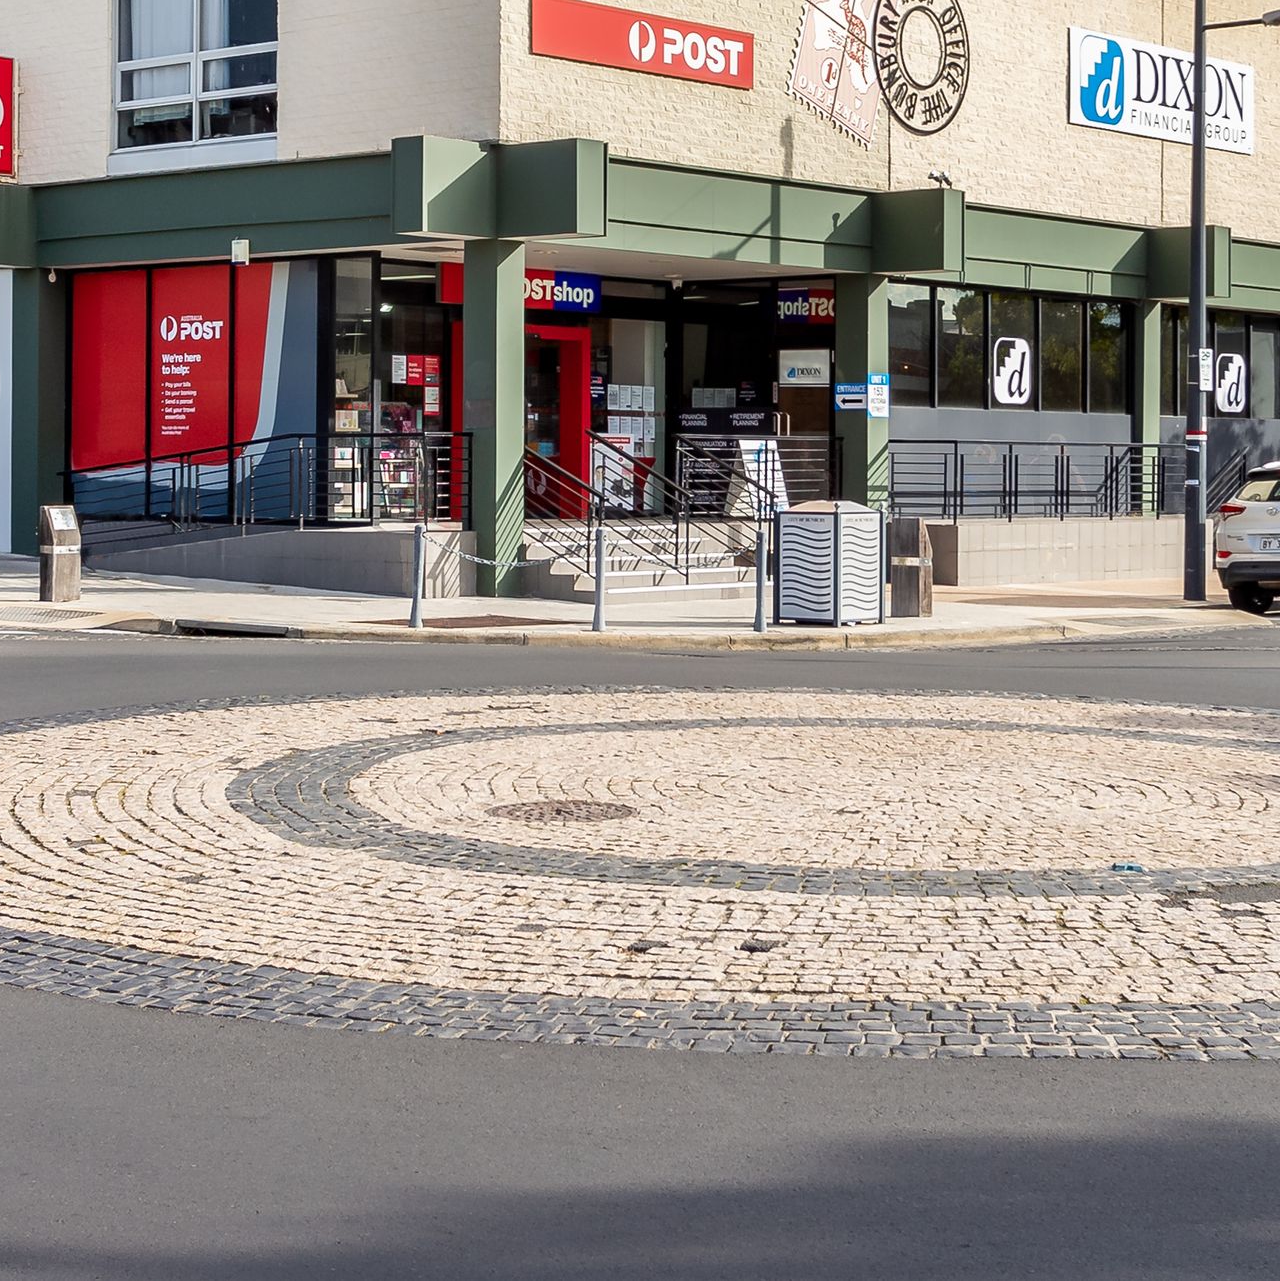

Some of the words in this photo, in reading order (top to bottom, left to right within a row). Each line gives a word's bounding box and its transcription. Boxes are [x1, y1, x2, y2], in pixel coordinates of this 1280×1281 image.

[663, 27, 744, 76] POST
[920, 88, 953, 126] THE
[938, 5, 966, 95] OFFICE
[1131, 48, 1247, 122] DIXON
[1131, 109, 1194, 134] FINANCIA
[1205, 123, 1247, 144] GROUP
[523, 278, 594, 308] OSTshop
[180, 321, 224, 340] POST
[161, 353, 183, 363] We're
[184, 353, 202, 362] here
[161, 365, 171, 375] to
[796, 367, 822, 377] DIXON
[836, 384, 867, 393] ENTRANCE
[1262, 540, 1272, 549] BY
